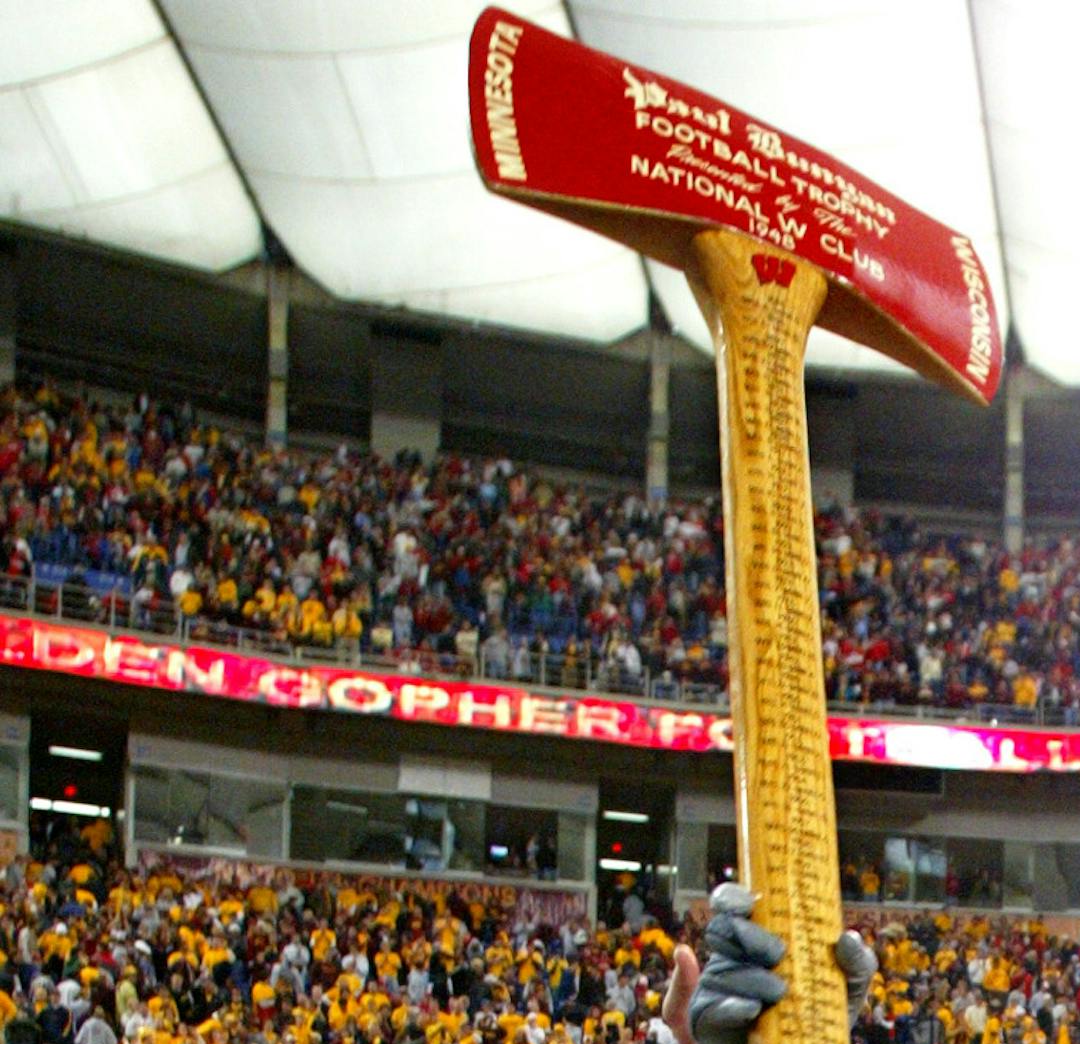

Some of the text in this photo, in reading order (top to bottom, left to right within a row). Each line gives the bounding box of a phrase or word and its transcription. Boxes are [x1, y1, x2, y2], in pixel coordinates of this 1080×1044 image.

[484, 20, 528, 182] MINNESOTA
[623, 67, 896, 225] Paul Bunyan
[630, 154, 886, 282] NATIONAL W CLUB
[635, 111, 890, 240] FOOTBALL TROPHY
[951, 235, 992, 385] WISCONSIN
[257, 670, 631, 740] GOPHER
